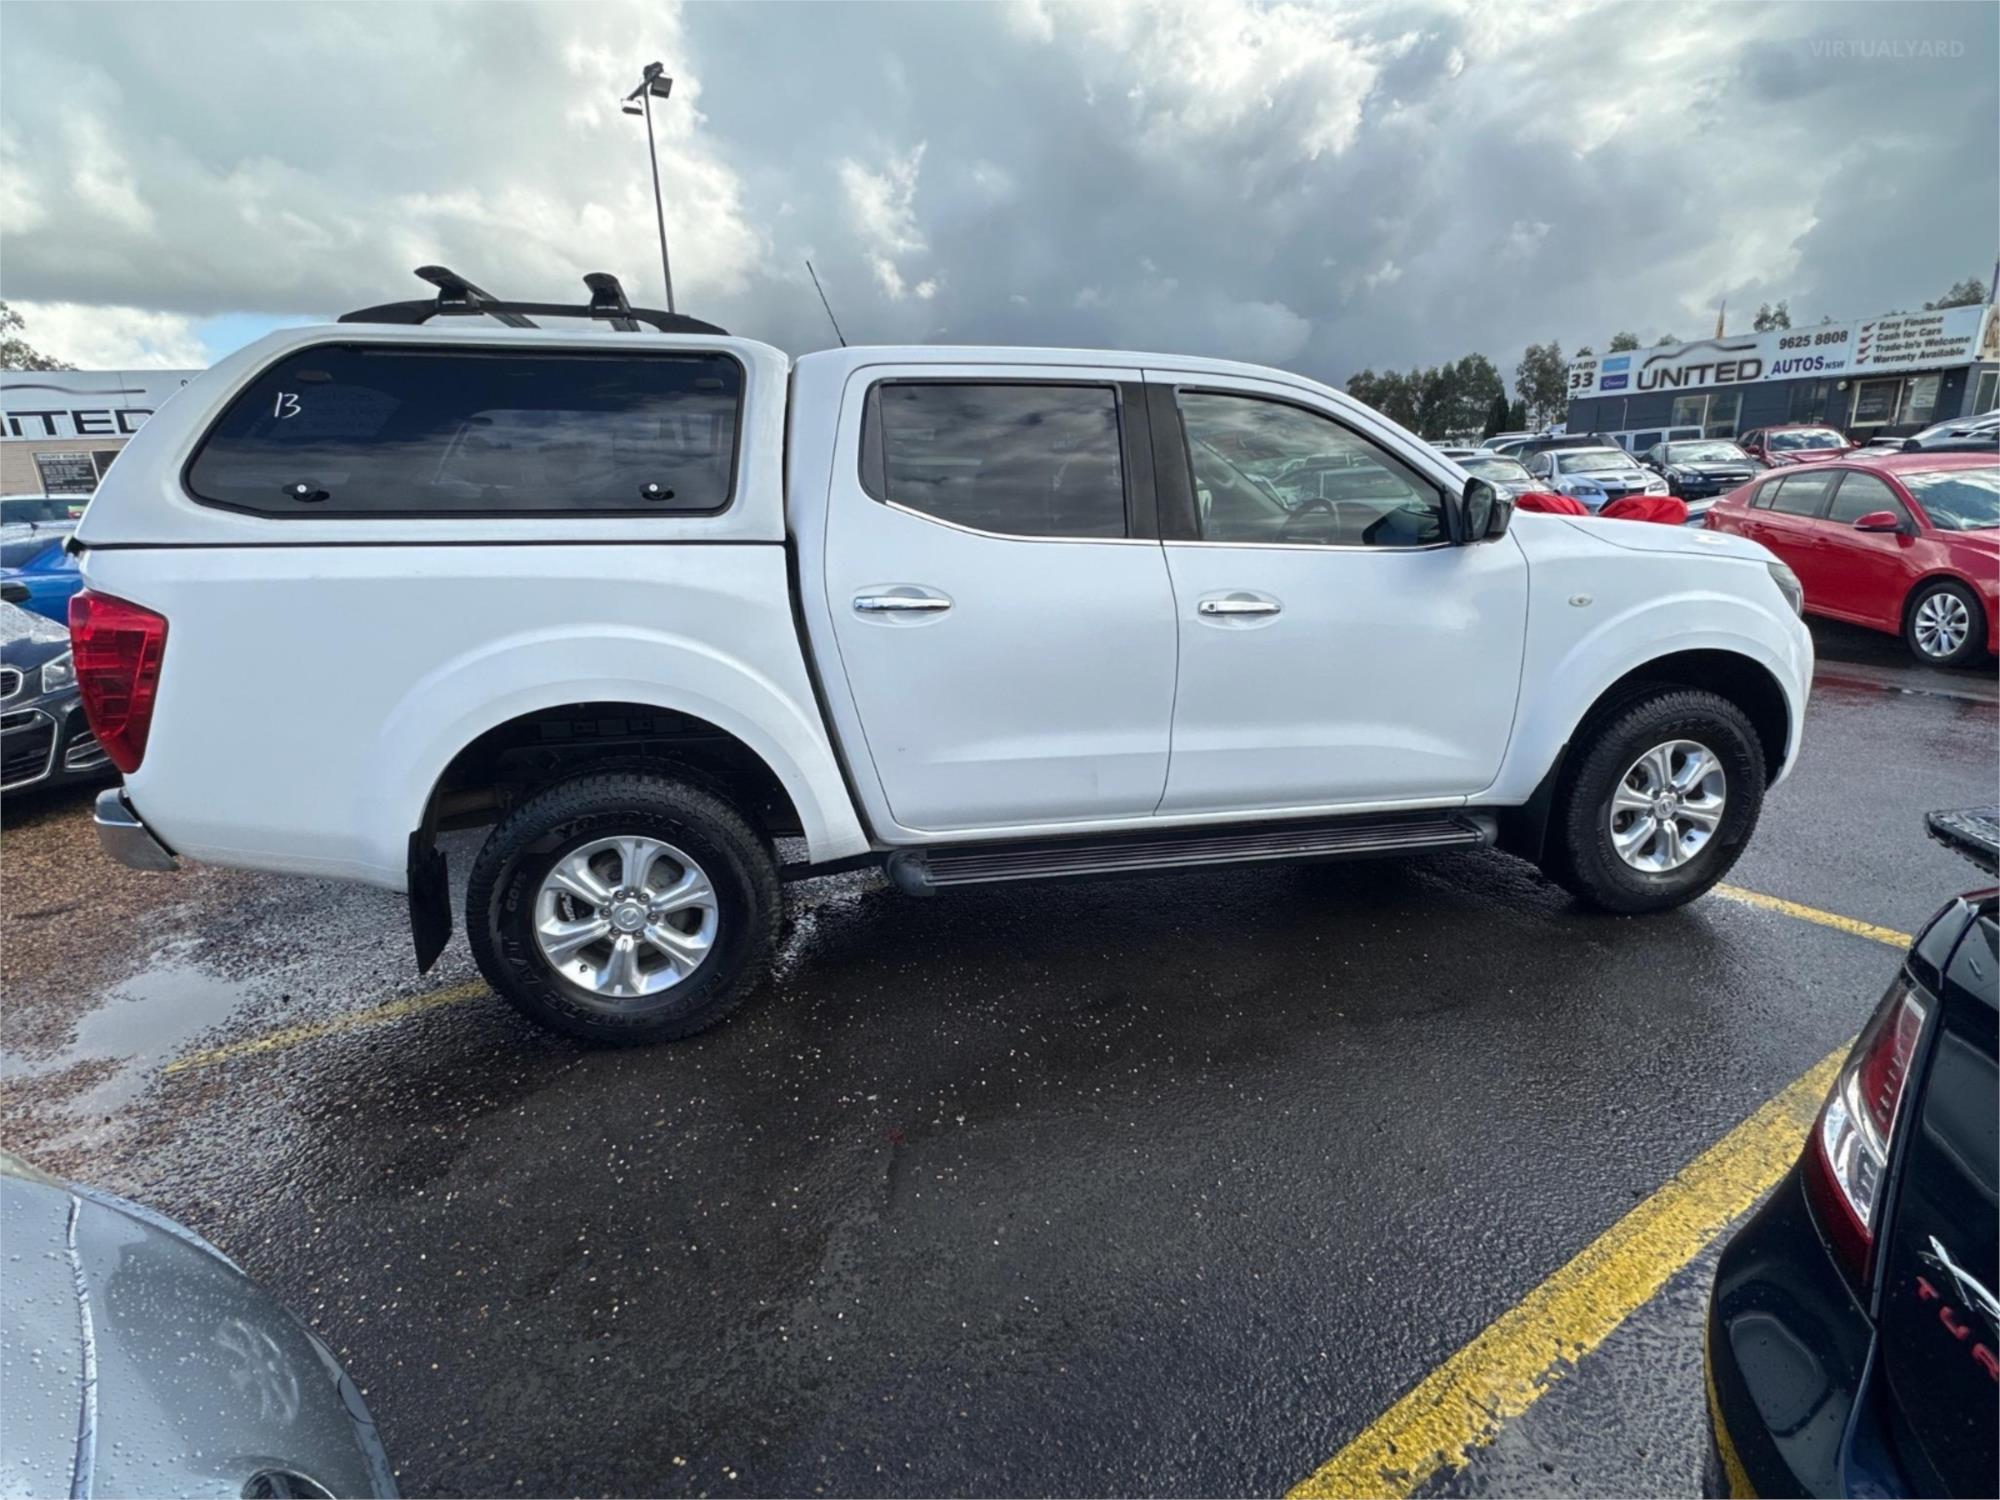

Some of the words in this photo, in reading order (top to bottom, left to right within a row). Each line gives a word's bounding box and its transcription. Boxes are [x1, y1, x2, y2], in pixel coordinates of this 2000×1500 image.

[1878, 320, 1902, 331] Easy
[1904, 315, 1944, 327] Finance
[1779, 335, 1811, 350] 9625
[1815, 330, 1849, 346] 8808
[1876, 332, 1900, 342] Cash
[1903, 330, 1917, 339] for
[1919, 327, 1943, 336] Cars
[1924, 336, 1971, 348] Welcome
[1872, 352, 1917, 364] Warranty
[1918, 347, 1966, 360] Available
[1570, 360, 1597, 370] YARD
[1637, 358, 1763, 390] UNITED
[1771, 356, 1825, 375] AUTOS
[1825, 361, 1845, 370] NSW
[1570, 371, 1594, 389] 33
[274, 391, 302, 419] 13
[0, 409, 155, 437] ITED
